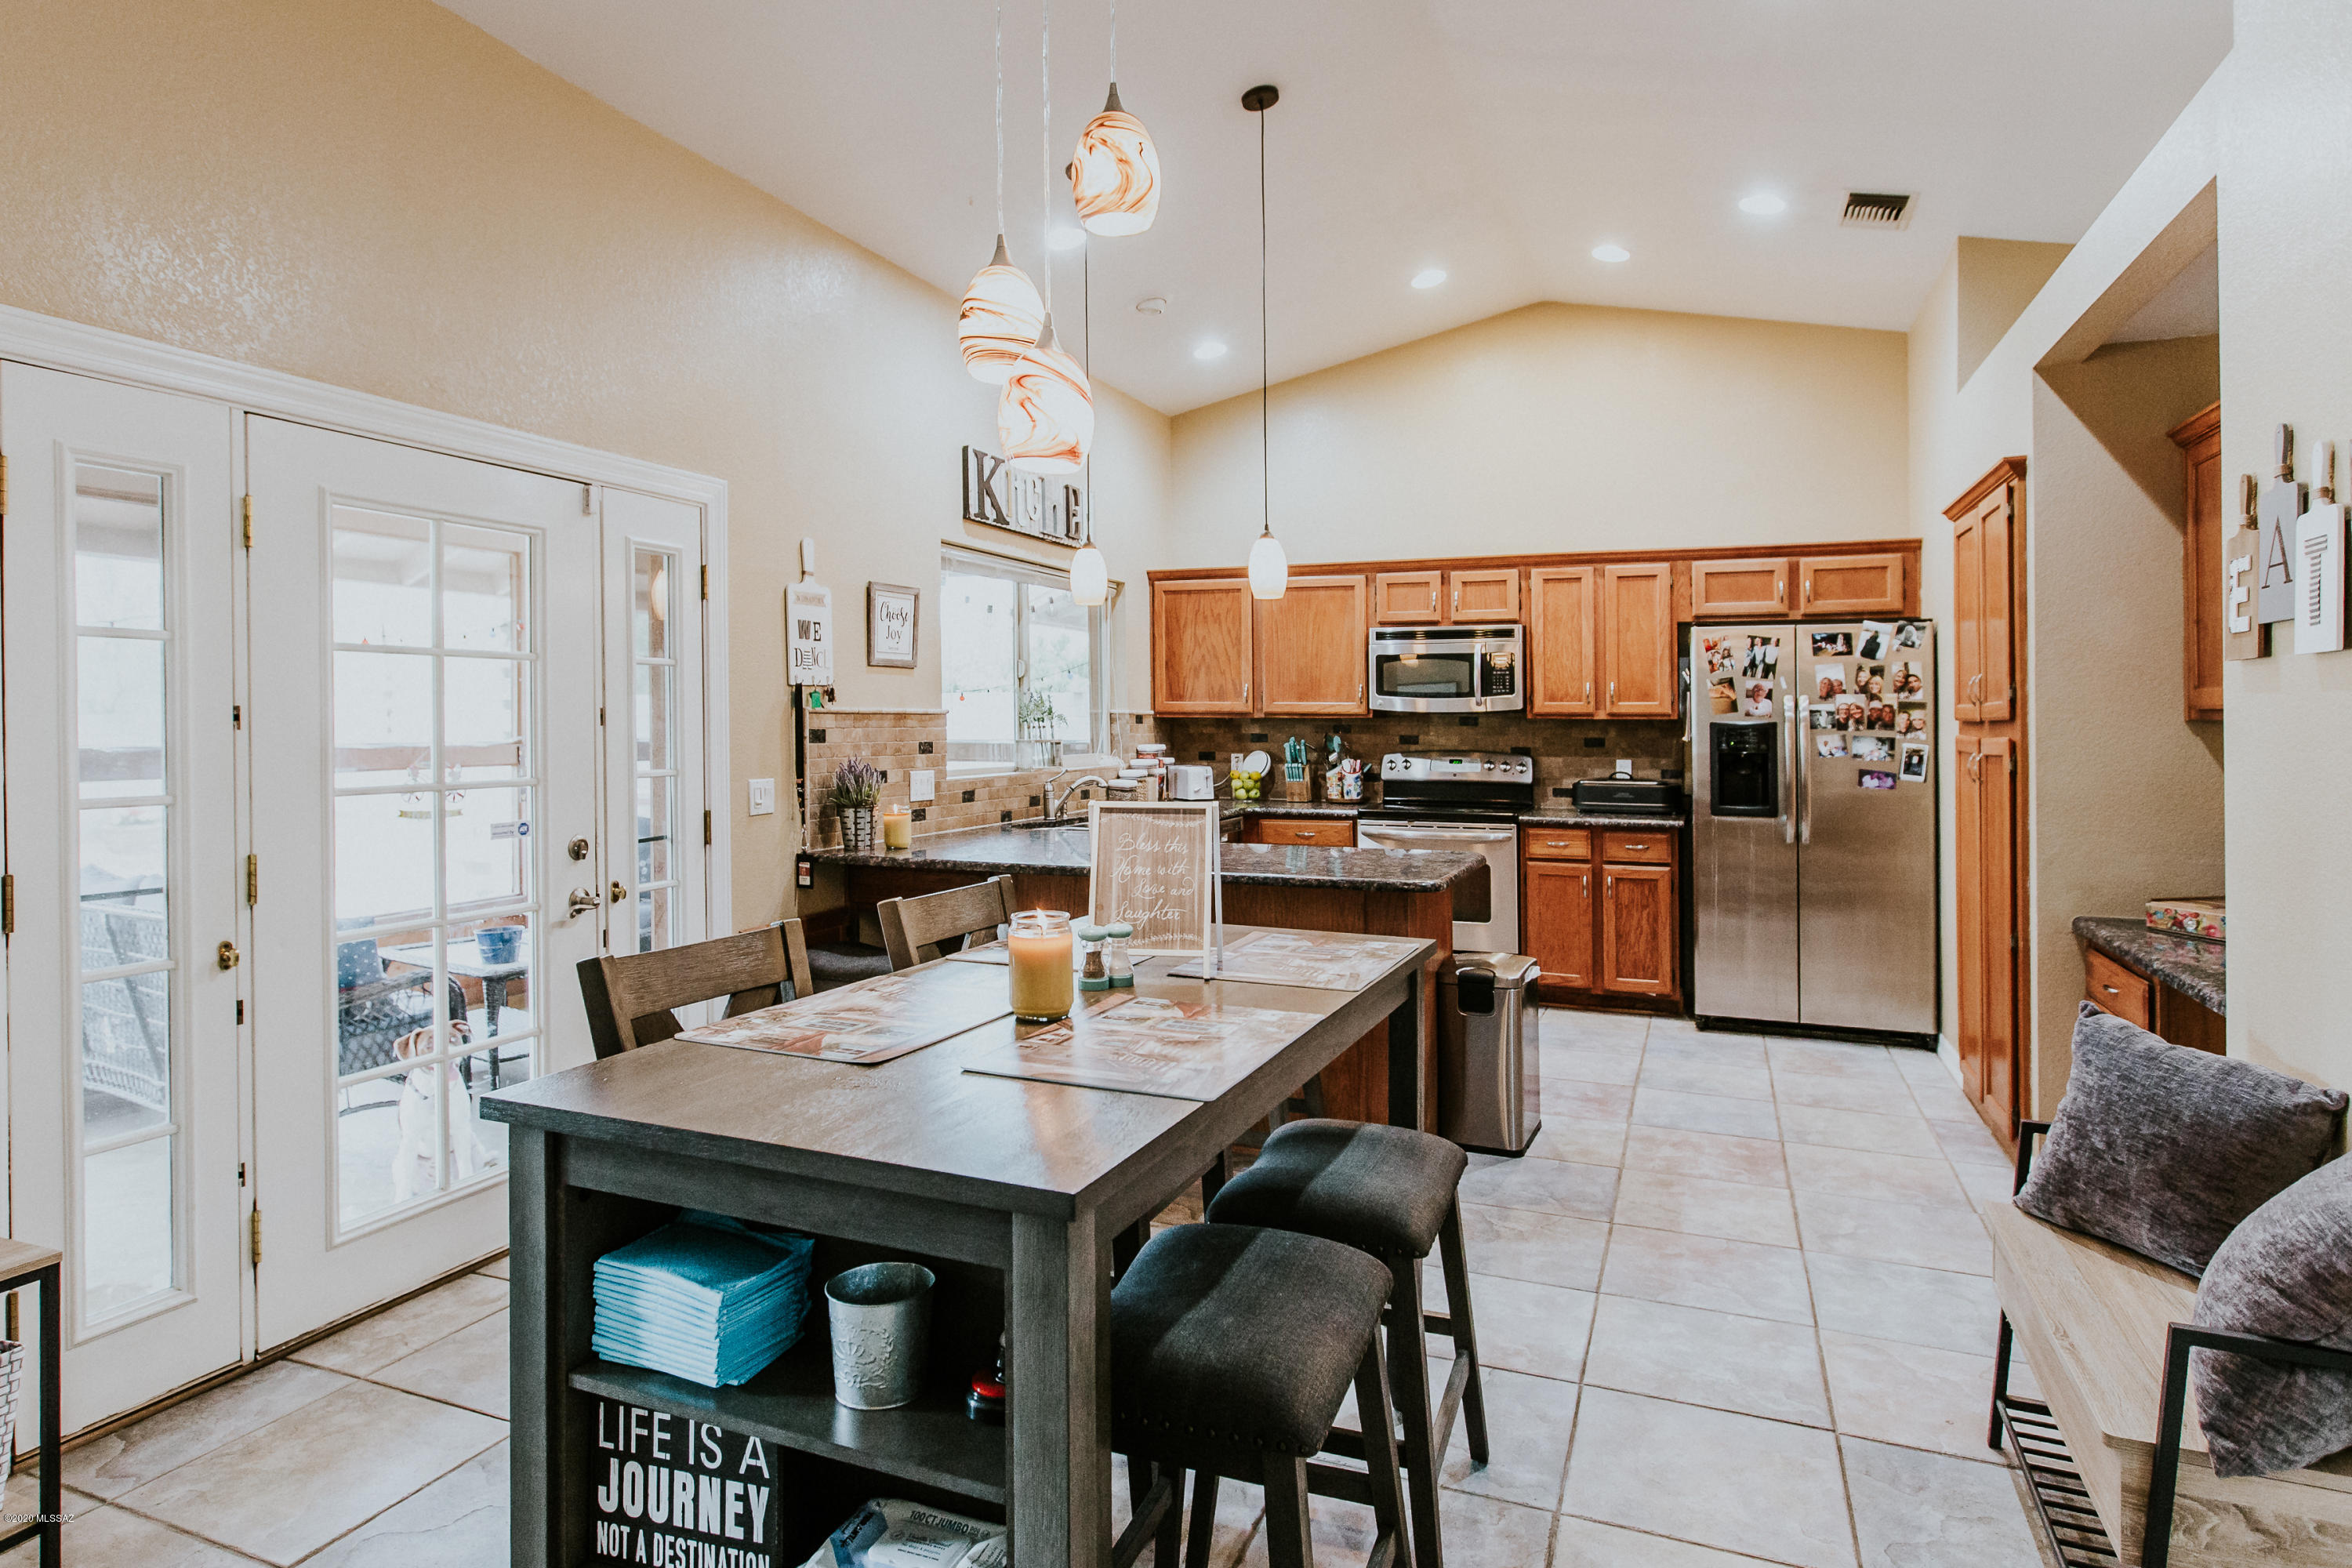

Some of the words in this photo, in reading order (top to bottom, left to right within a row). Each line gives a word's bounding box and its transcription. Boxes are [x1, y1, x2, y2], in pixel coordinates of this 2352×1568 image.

[880, 601, 908, 627] Choose
[797, 619, 821, 641] WE
[1116, 833, 1160, 852] Bless
[1164, 835, 1189, 855] this
[1110, 855, 1152, 883] Home
[1157, 858, 1190, 875] with
[1131, 878, 1166, 899] Love
[1171, 877, 1196, 896] and
[1113, 898, 1186, 931] Laughter
[599, 1401, 671, 1461] LIFE
[688, 1419, 722, 1469] IS
[739, 1436, 770, 1479] A
[597, 1457, 770, 1544] JOURNEY
[937, 1518, 970, 1534] JUMBO
[597, 1520, 630, 1559] NOT
[635, 1529, 647, 1564] A
